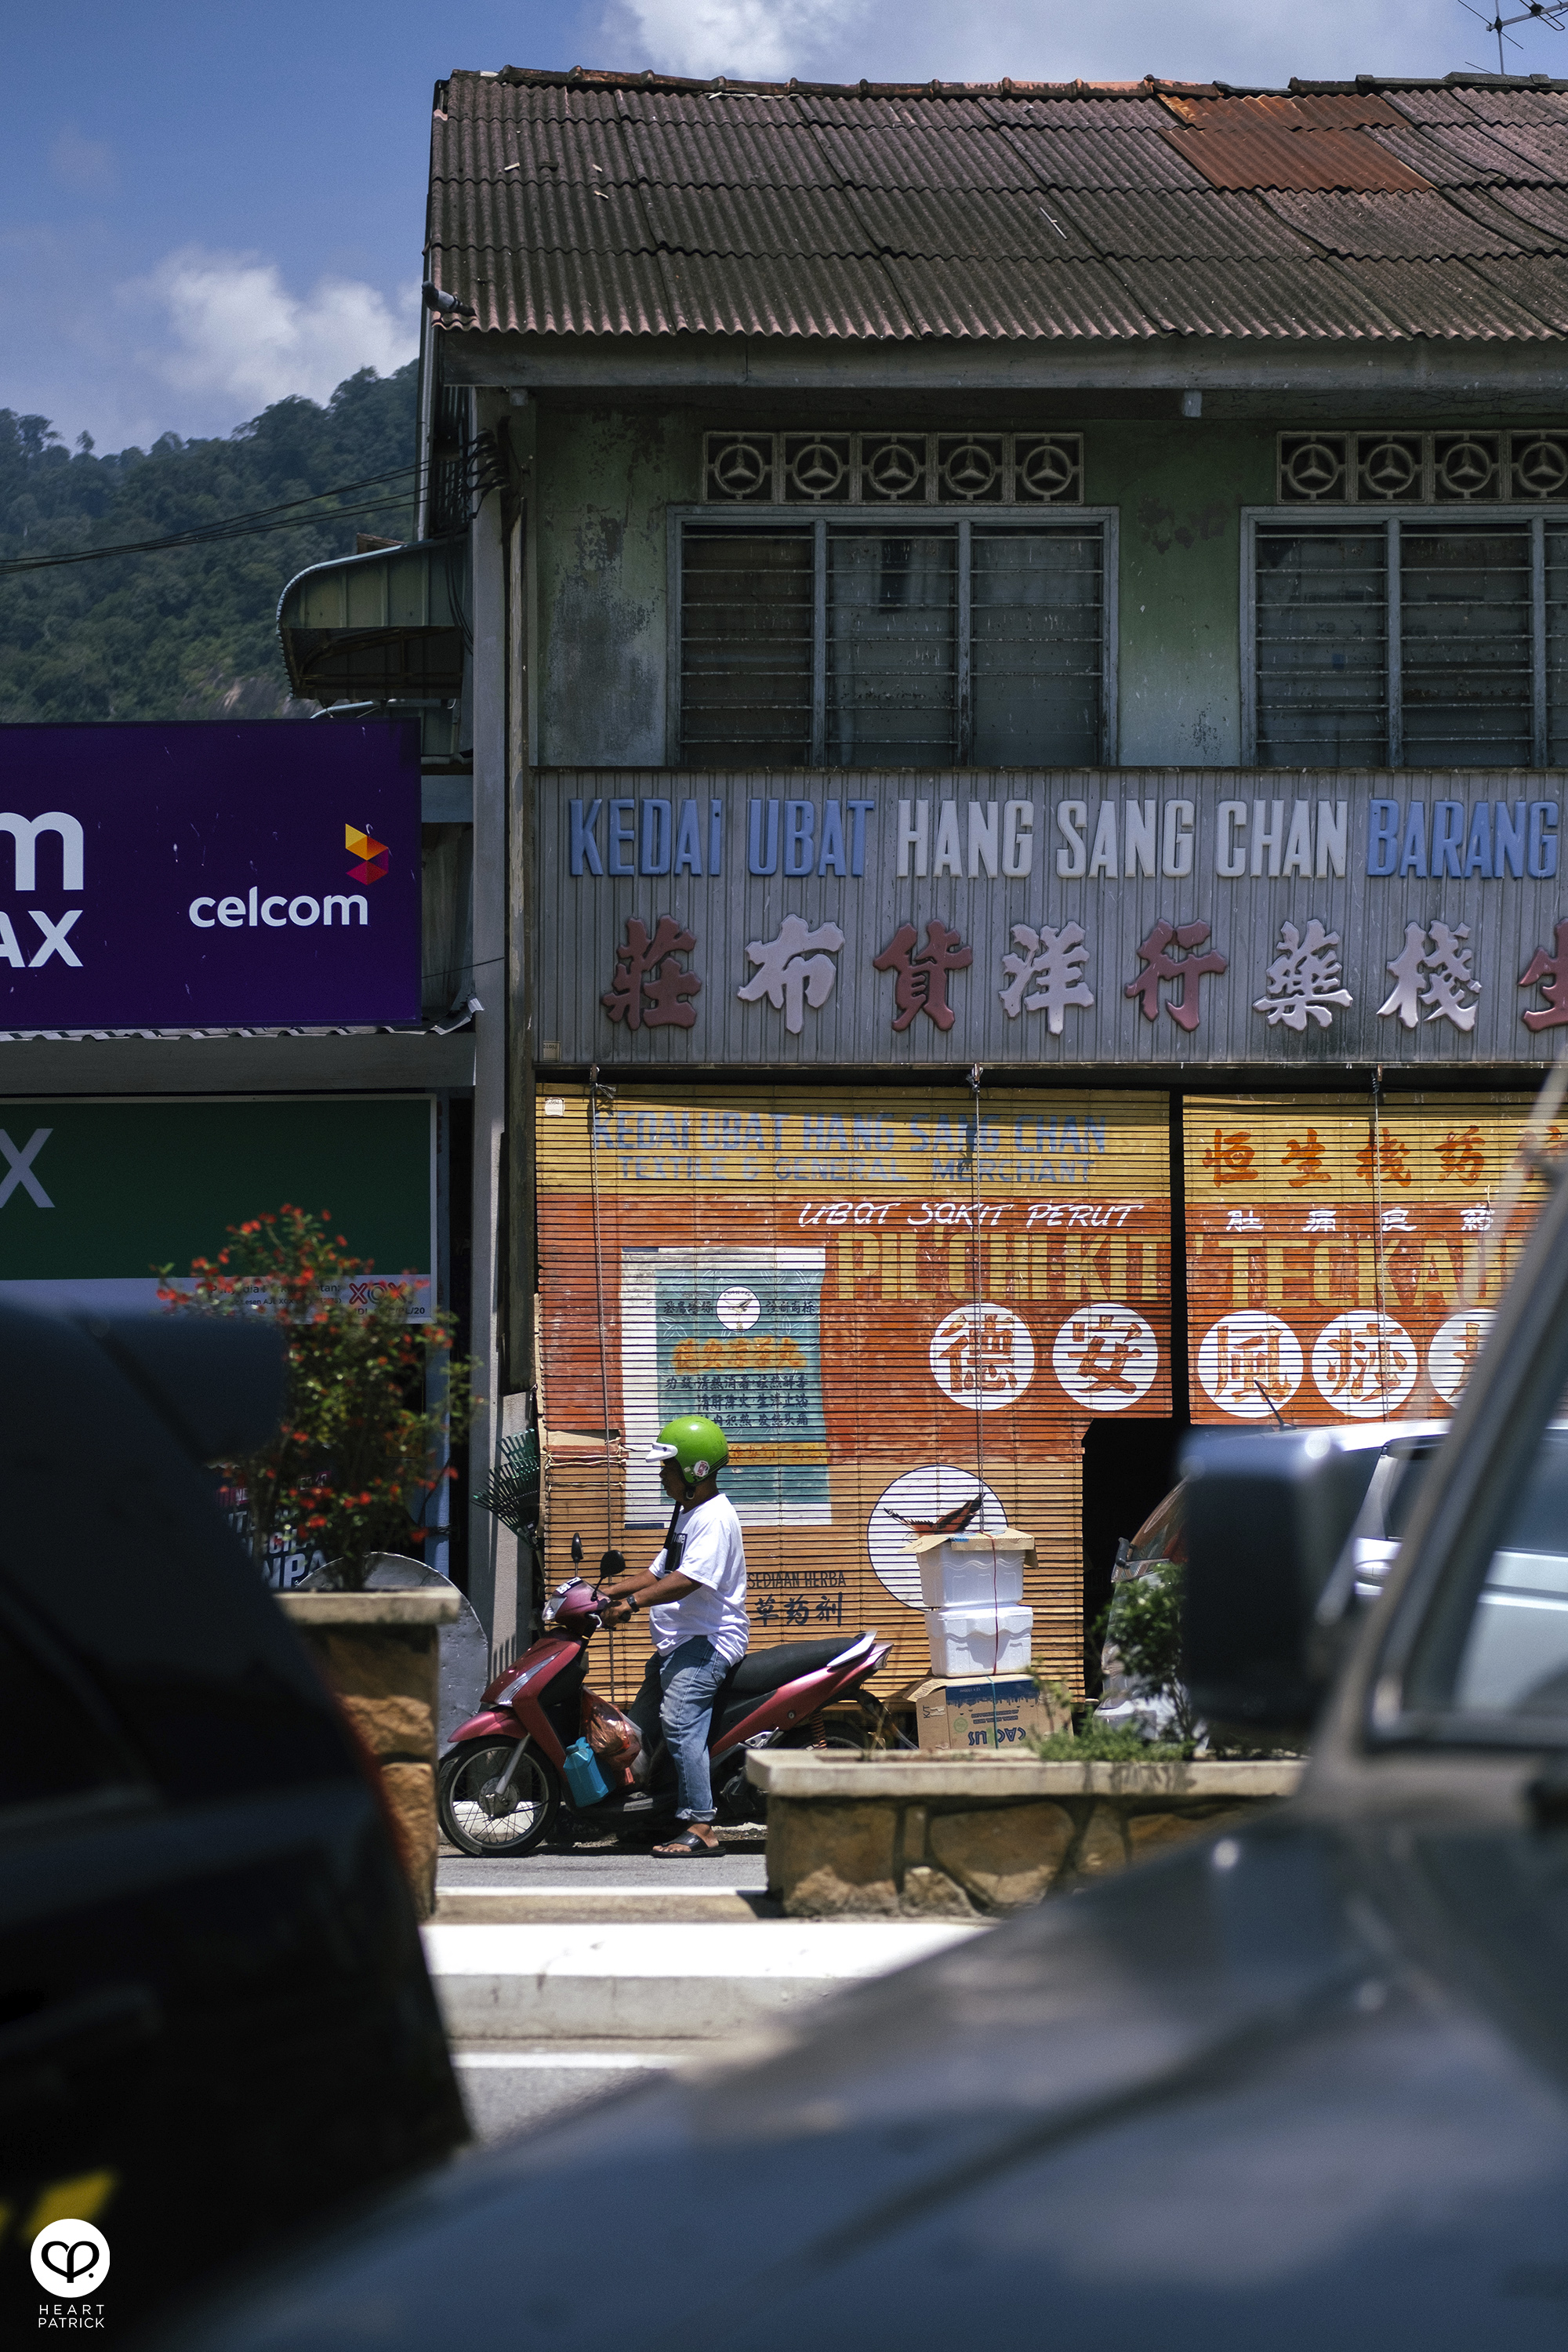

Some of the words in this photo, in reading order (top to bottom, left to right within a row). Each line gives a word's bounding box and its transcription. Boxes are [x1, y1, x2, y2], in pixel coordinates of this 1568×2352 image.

[569, 799, 723, 877] KEDAI
[748, 800, 874, 877] UBAT
[896, 800, 1035, 878] HANG
[1056, 800, 1194, 878] SANG
[1216, 800, 1348, 878] CHAN
[1367, 799, 1559, 879] BARANG
[189, 886, 368, 927] celcom
[594, 1111, 691, 1149] KEDAI
[700, 1112, 791, 1150] UBAT
[803, 1113, 895, 1151] HANG
[910, 1113, 1000, 1152] SANG
[1014, 1115, 1106, 1154] CHAN
[618, 1156, 728, 1179] TEXTILE
[774, 1156, 908, 1181] GENERAL
[931, 1158, 1095, 1183] MERCHANT
[1025, 1203, 1145, 1229] PERUT
[747, 1571, 800, 1588] SEDIAAN
[804, 1570, 847, 1588] HERBA
